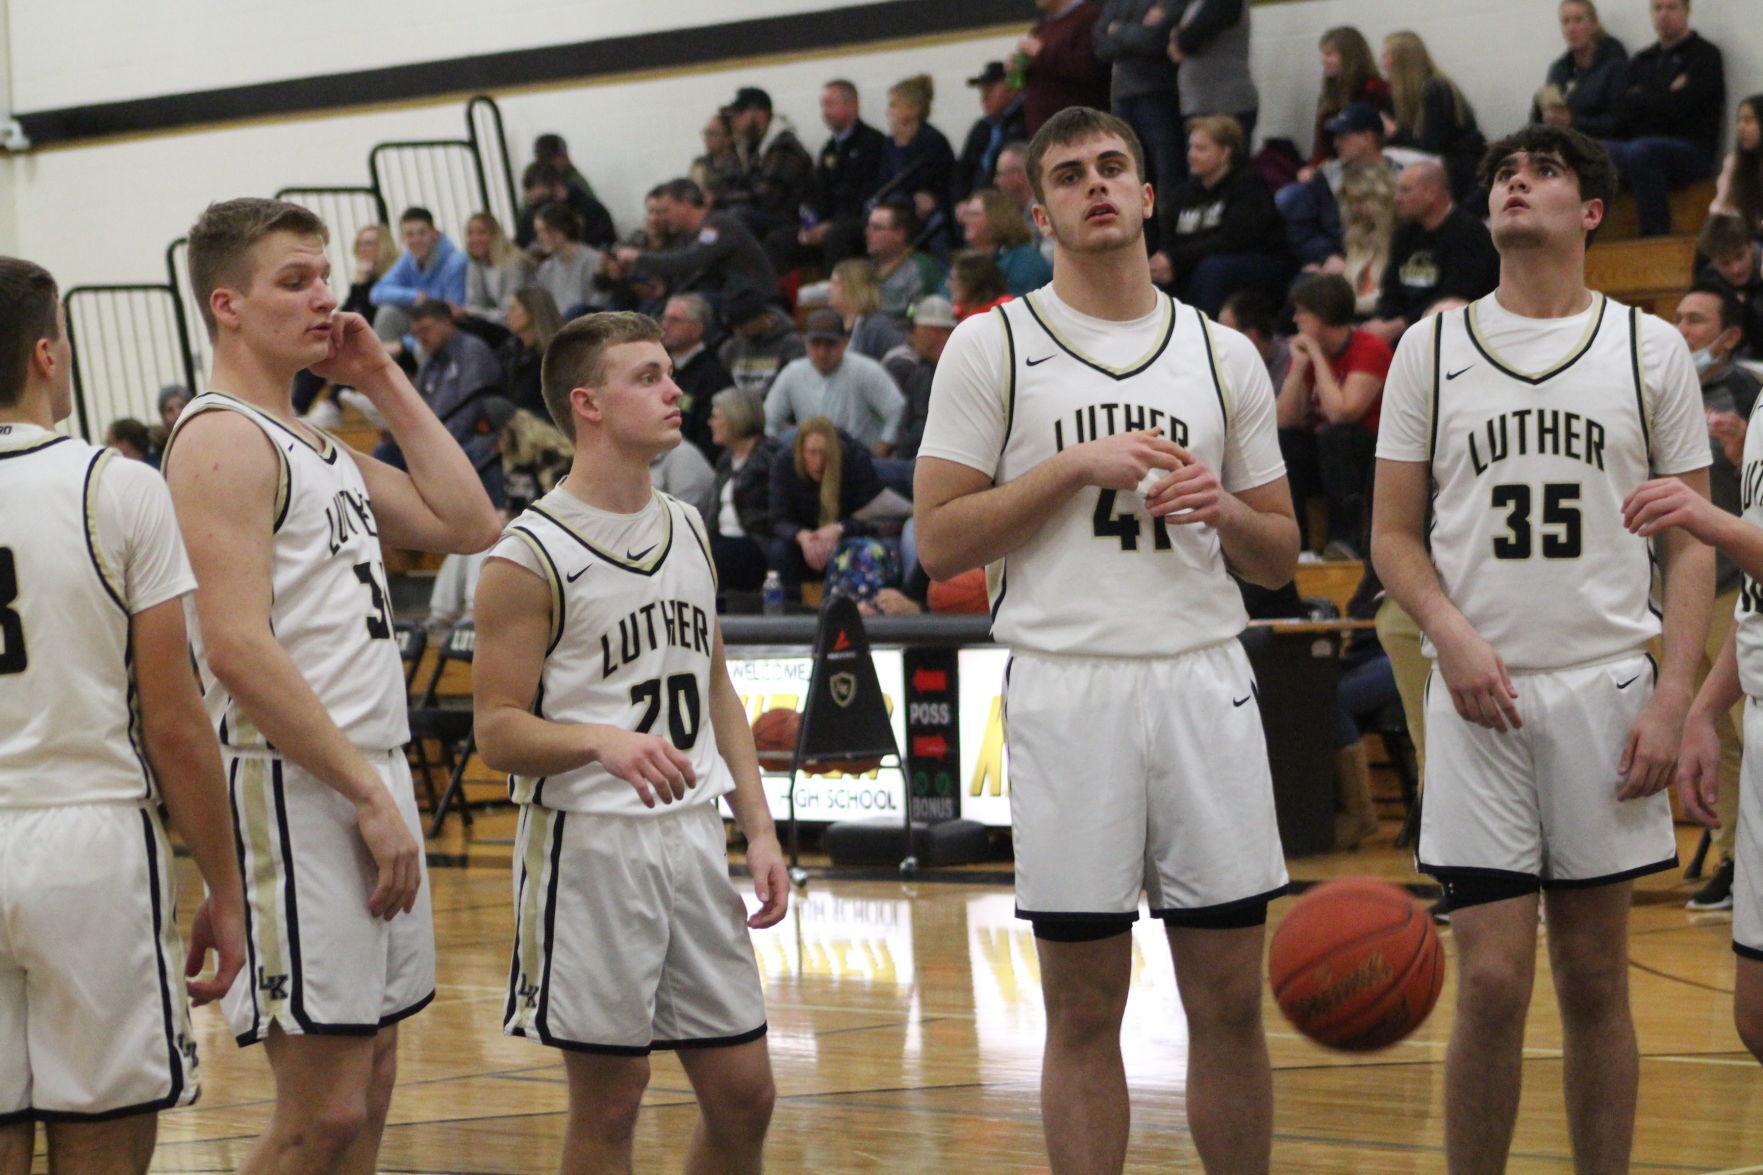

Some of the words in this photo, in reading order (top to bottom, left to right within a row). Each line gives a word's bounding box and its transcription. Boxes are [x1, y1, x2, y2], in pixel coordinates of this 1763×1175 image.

[1468, 409, 1606, 477] LUTHER
[1490, 482, 1582, 561] 35
[600, 600, 711, 680] LUTHER
[909, 702, 949, 725] POSS
[778, 788, 819, 809] HGH
[826, 789, 897, 811] SCHOOL
[911, 796, 953, 818] BONUS
